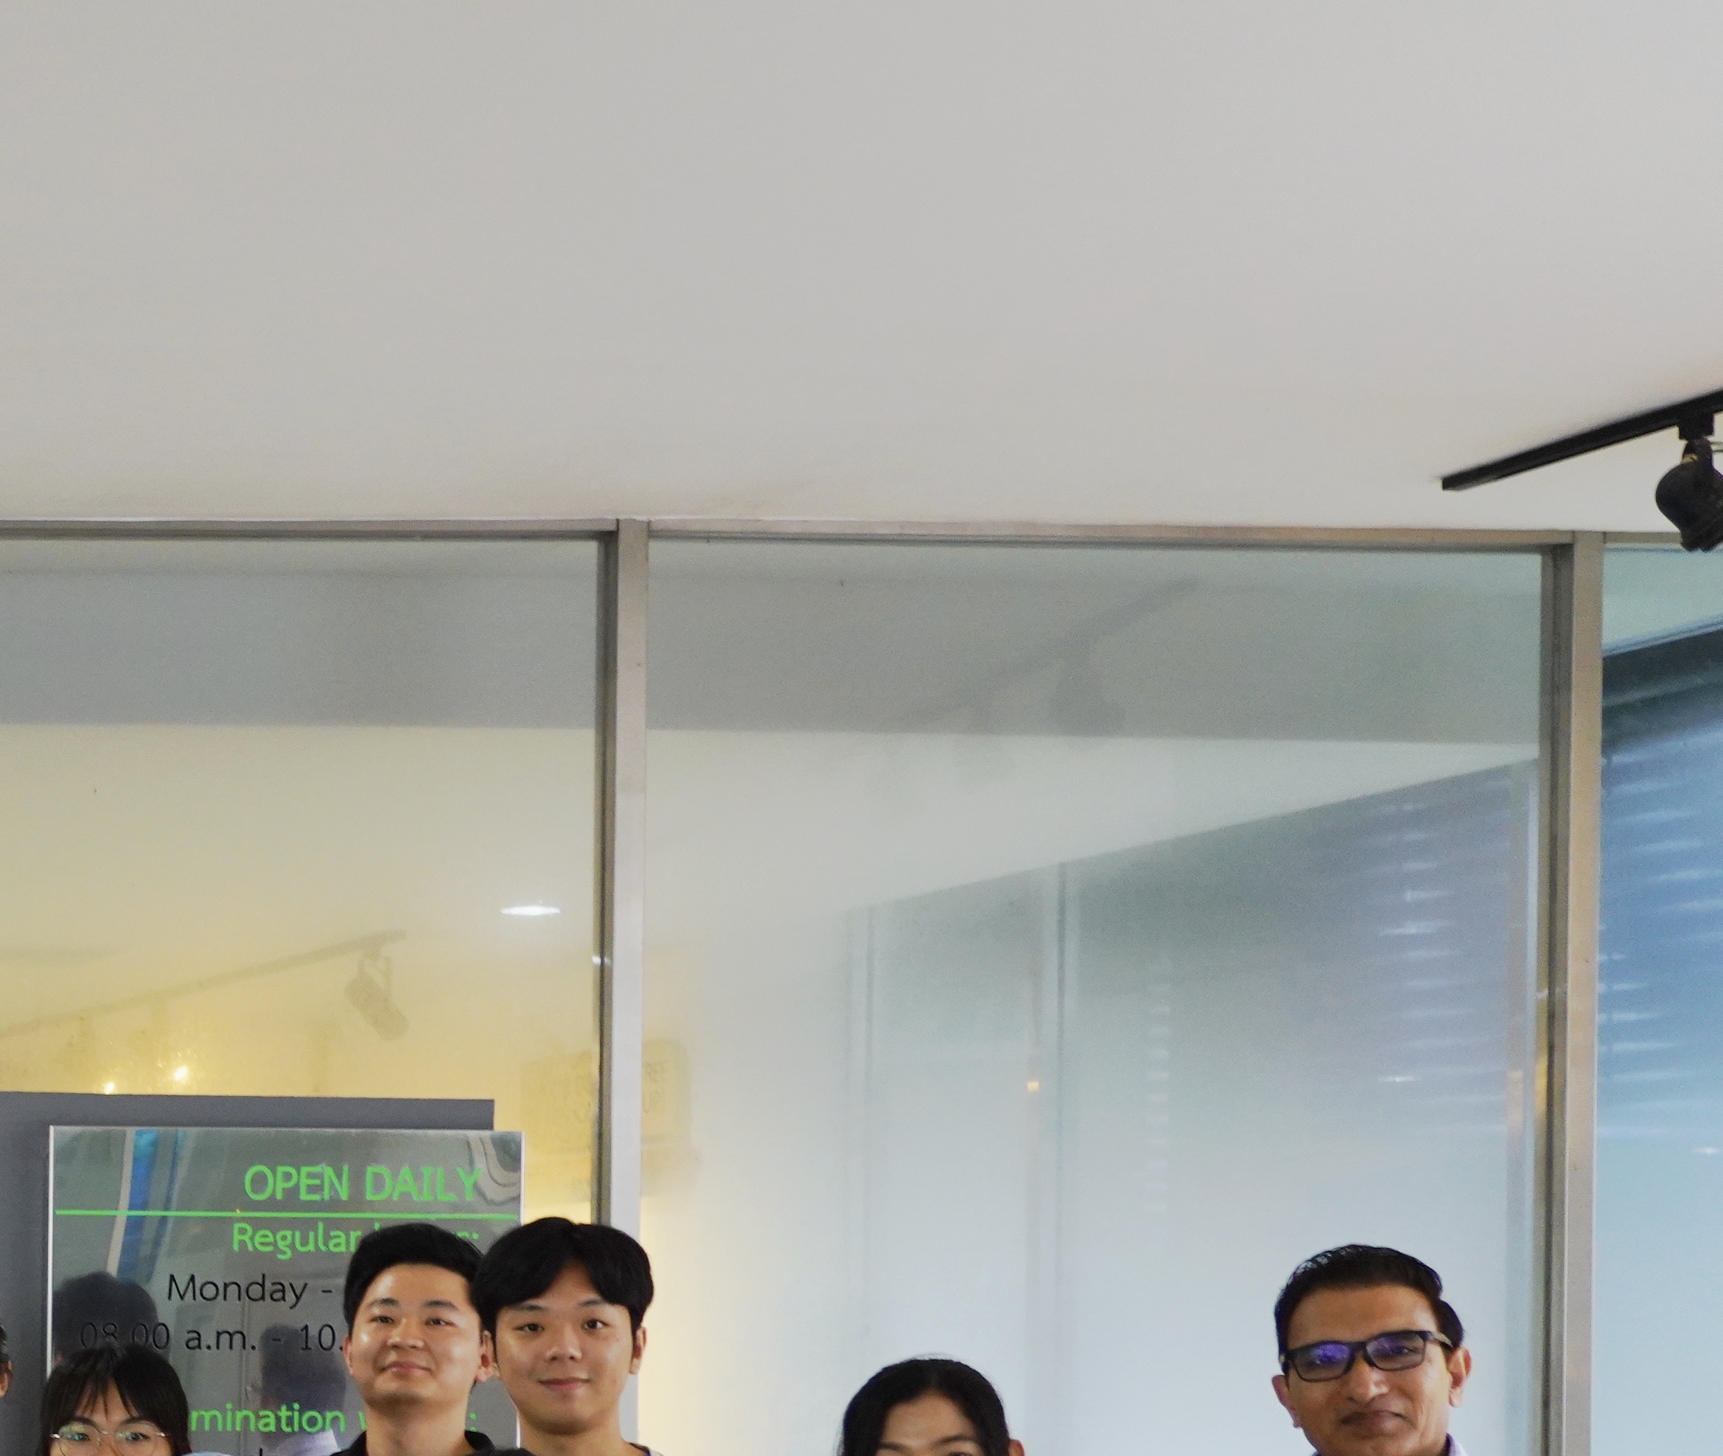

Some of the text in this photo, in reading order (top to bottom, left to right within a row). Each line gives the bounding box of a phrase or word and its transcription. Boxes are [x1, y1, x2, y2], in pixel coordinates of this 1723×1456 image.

[243, 1163, 483, 1203] OPEN DAILY
[232, 1221, 362, 1260] Regular
[167, 1273, 308, 1310] Monday
[184, 1329, 257, 1352] a.m.
[190, 1402, 346, 1433] mination
